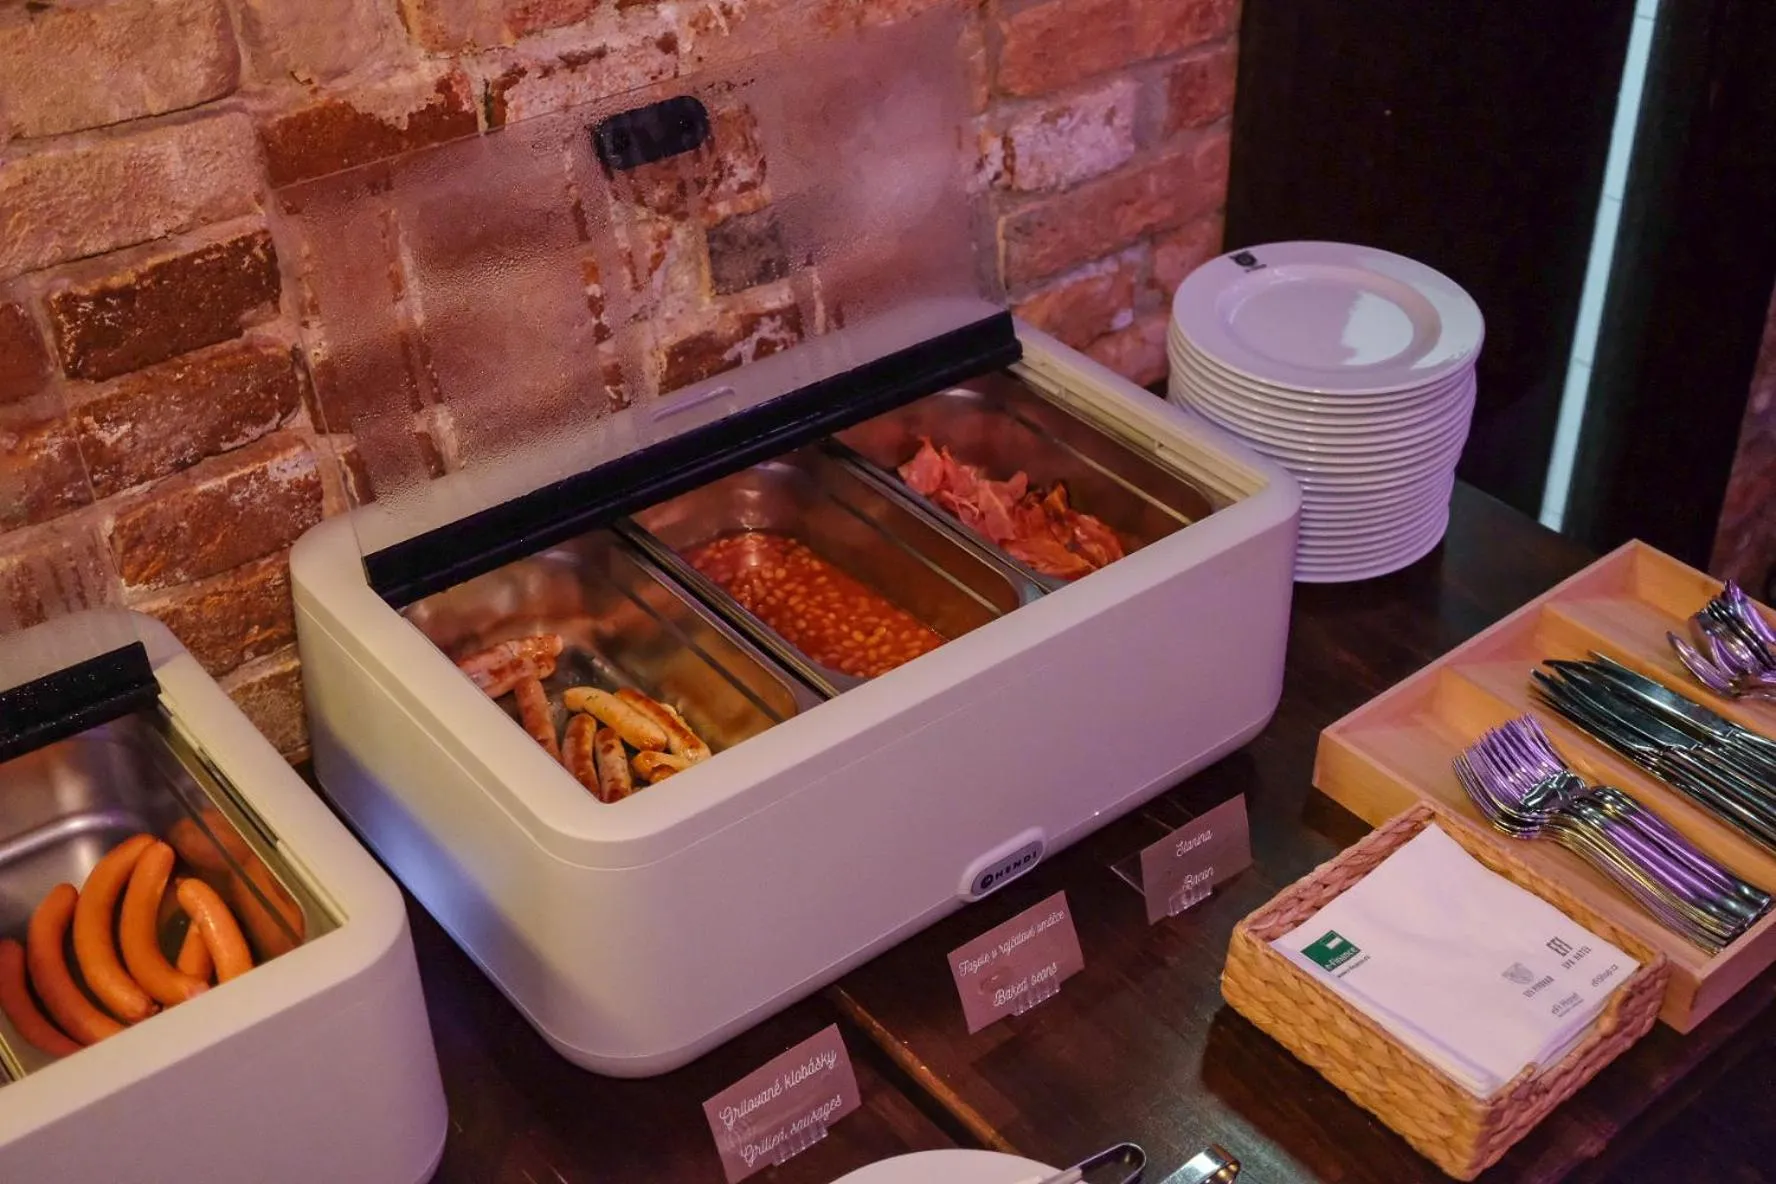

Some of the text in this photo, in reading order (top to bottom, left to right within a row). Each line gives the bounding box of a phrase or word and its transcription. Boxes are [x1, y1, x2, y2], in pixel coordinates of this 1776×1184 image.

[995, 850, 1037, 880] HENDI
[1183, 866, 1214, 890] Bacon
[719, 1048, 838, 1132] Grilované klobásky
[789, 1093, 843, 1135] sausages
